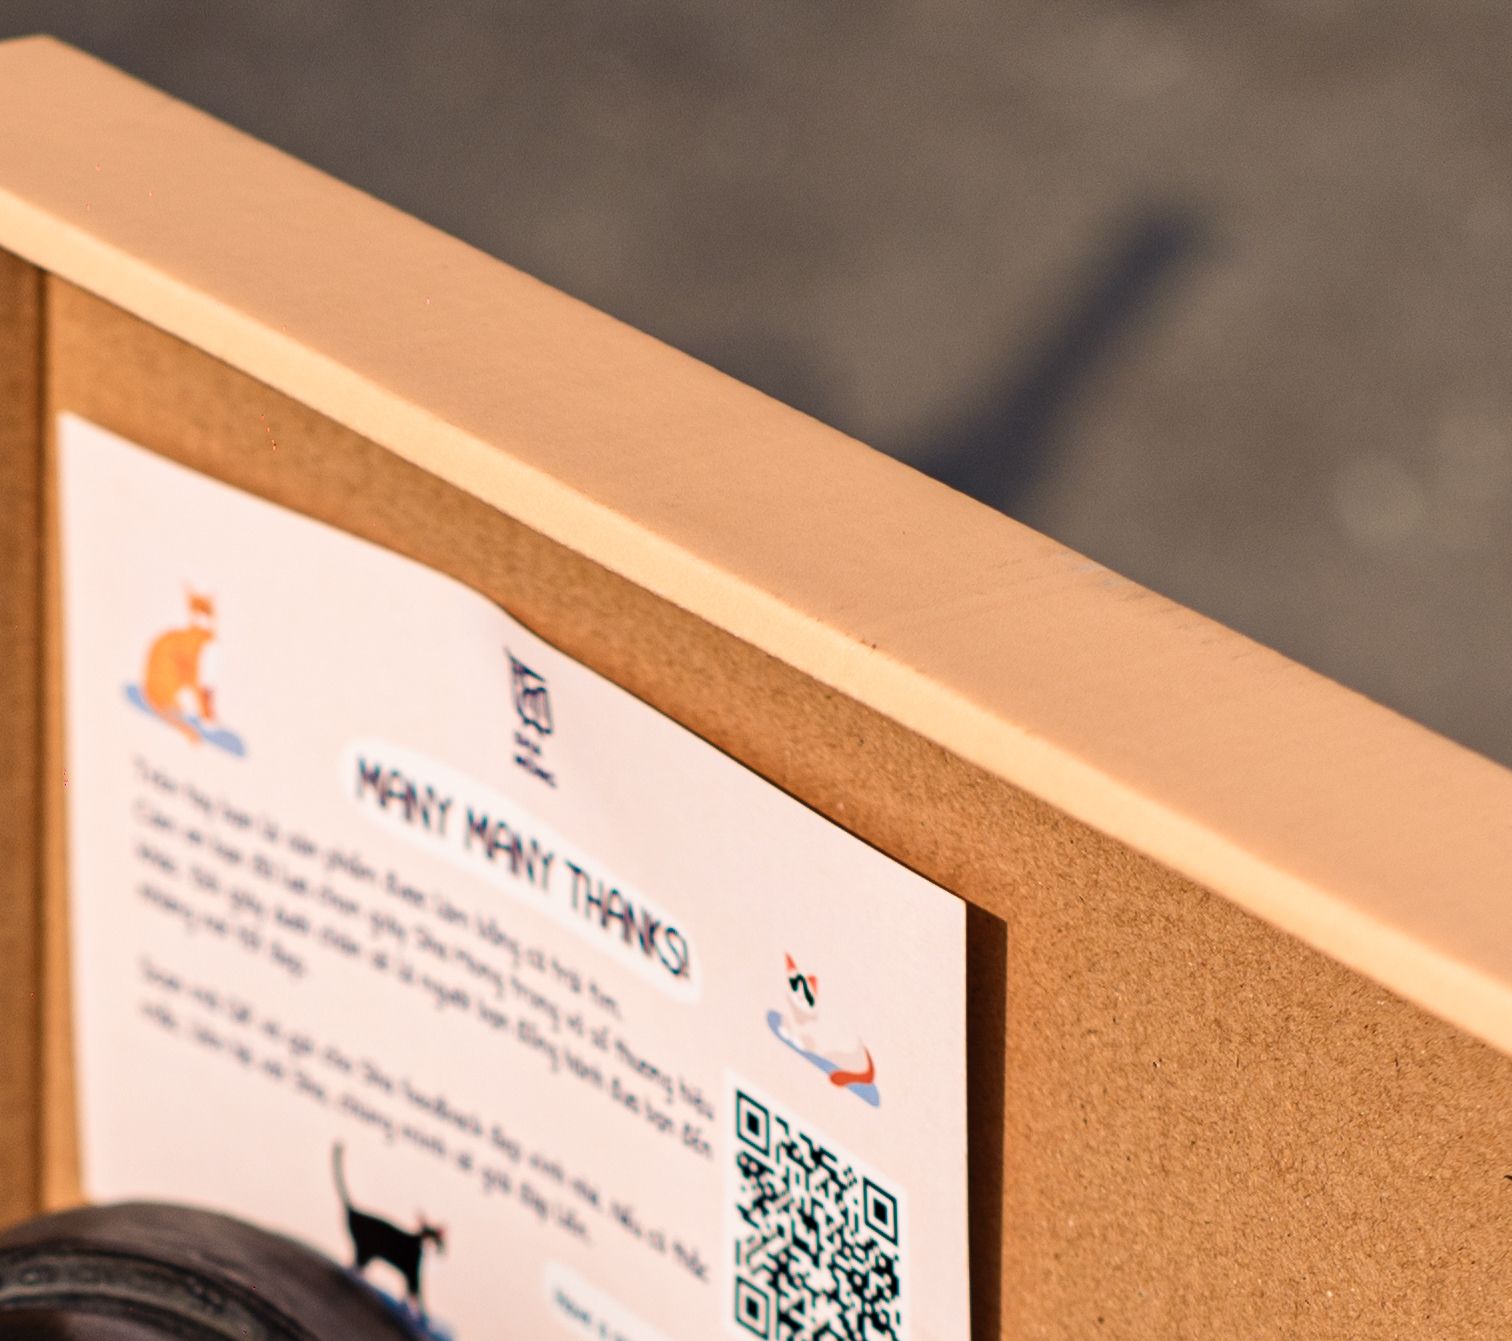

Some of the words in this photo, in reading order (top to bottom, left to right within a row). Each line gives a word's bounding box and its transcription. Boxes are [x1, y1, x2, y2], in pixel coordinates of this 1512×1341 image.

[356, 756, 453, 837] MANY
[463, 803, 555, 890] MANY
[564, 857, 693, 980] THANKS!
